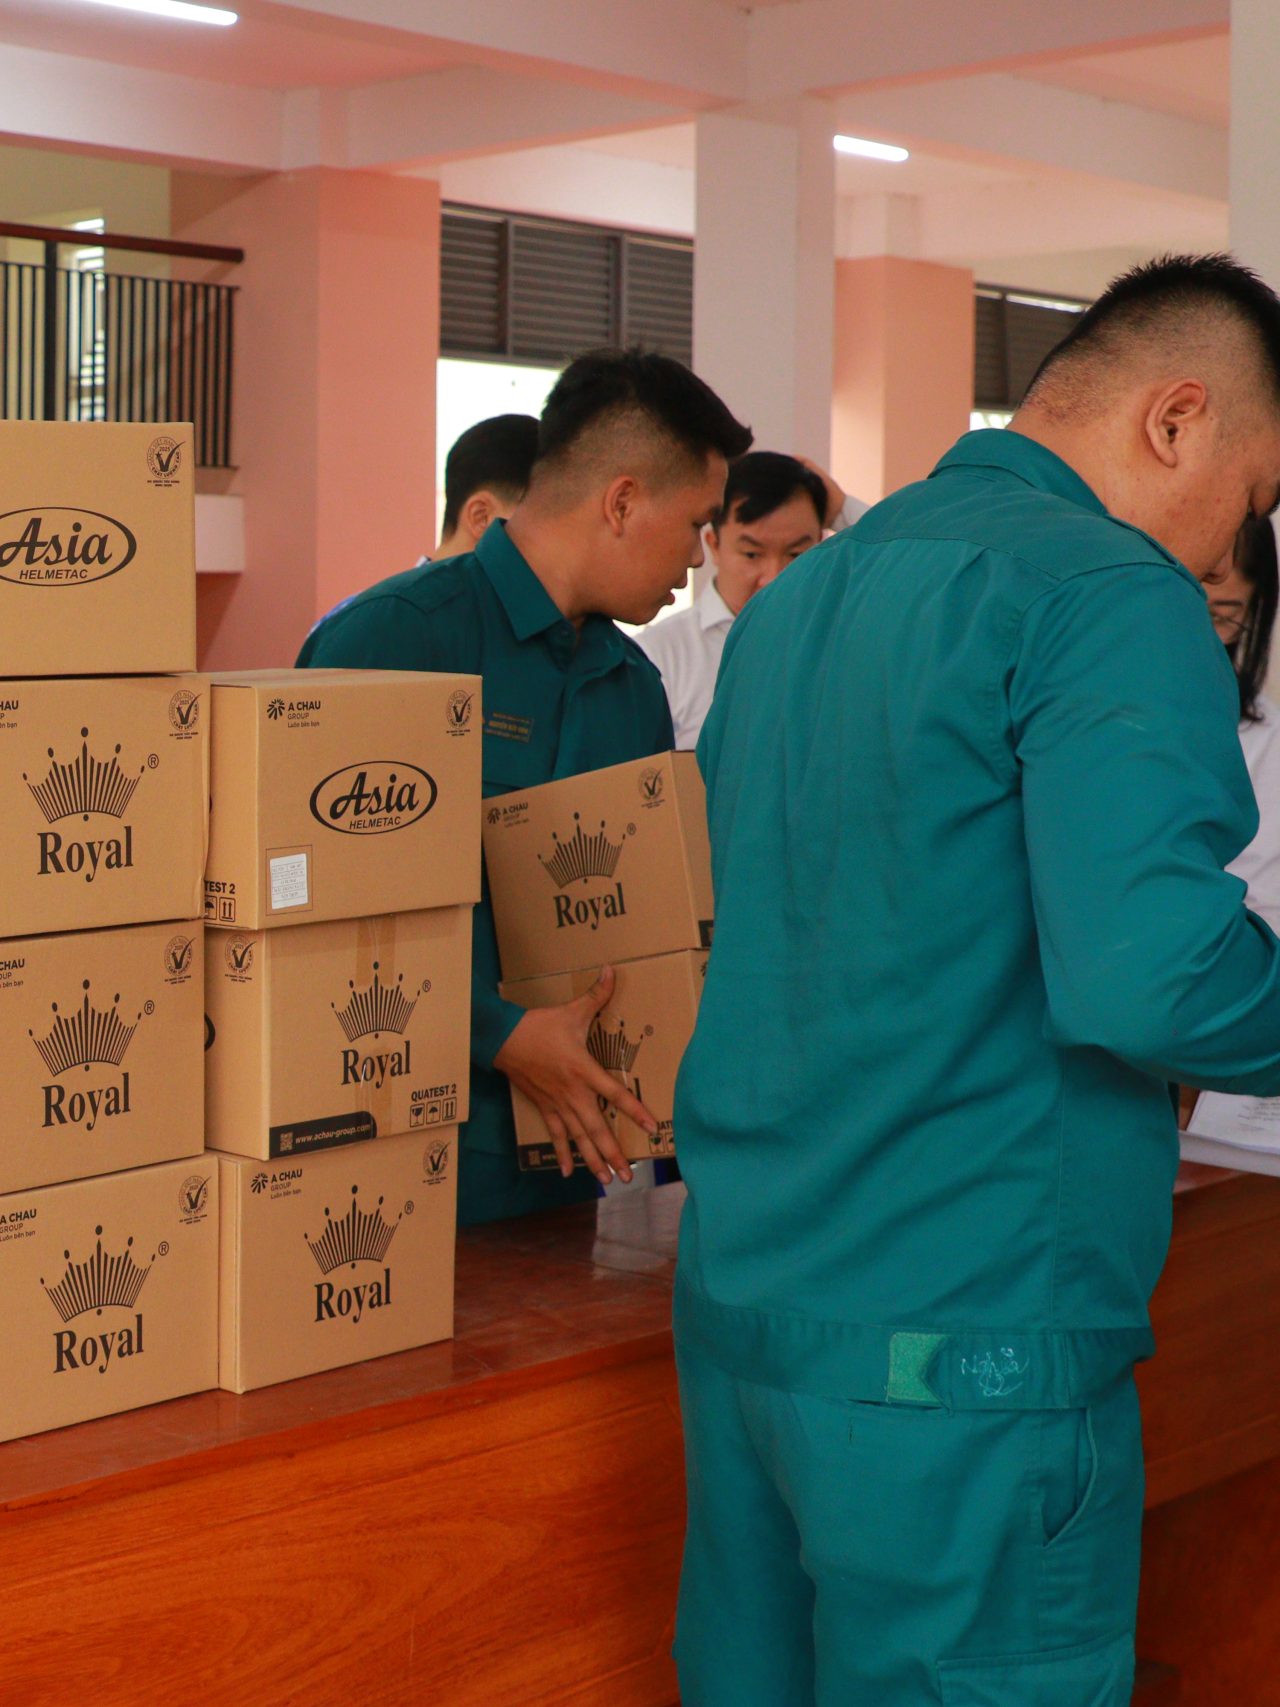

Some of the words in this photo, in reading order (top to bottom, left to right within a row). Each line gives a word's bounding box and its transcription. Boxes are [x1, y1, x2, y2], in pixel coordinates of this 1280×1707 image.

[19, 568, 88, 581] HELMETAC
[288, 702, 295, 711] A
[296, 700, 321, 711] CHAU
[329, 771, 419, 820] Asia
[349, 816, 401, 830] HELMETAC
[37, 825, 133, 883] Royal
[229, 883, 235, 894] 2
[552, 882, 626, 930] Royal
[341, 1040, 411, 1089] Royal
[41, 1072, 130, 1132] Royal
[411, 1085, 449, 1102] QUATEST
[450, 1084, 457, 1095] 2
[271, 1174, 277, 1183] A
[279, 1168, 303, 1181] CHAU
[0, 1215, 7, 1225] A
[9, 1208, 37, 1223] CHAU
[314, 1268, 392, 1324] Royal
[53, 1313, 144, 1374] Royal
